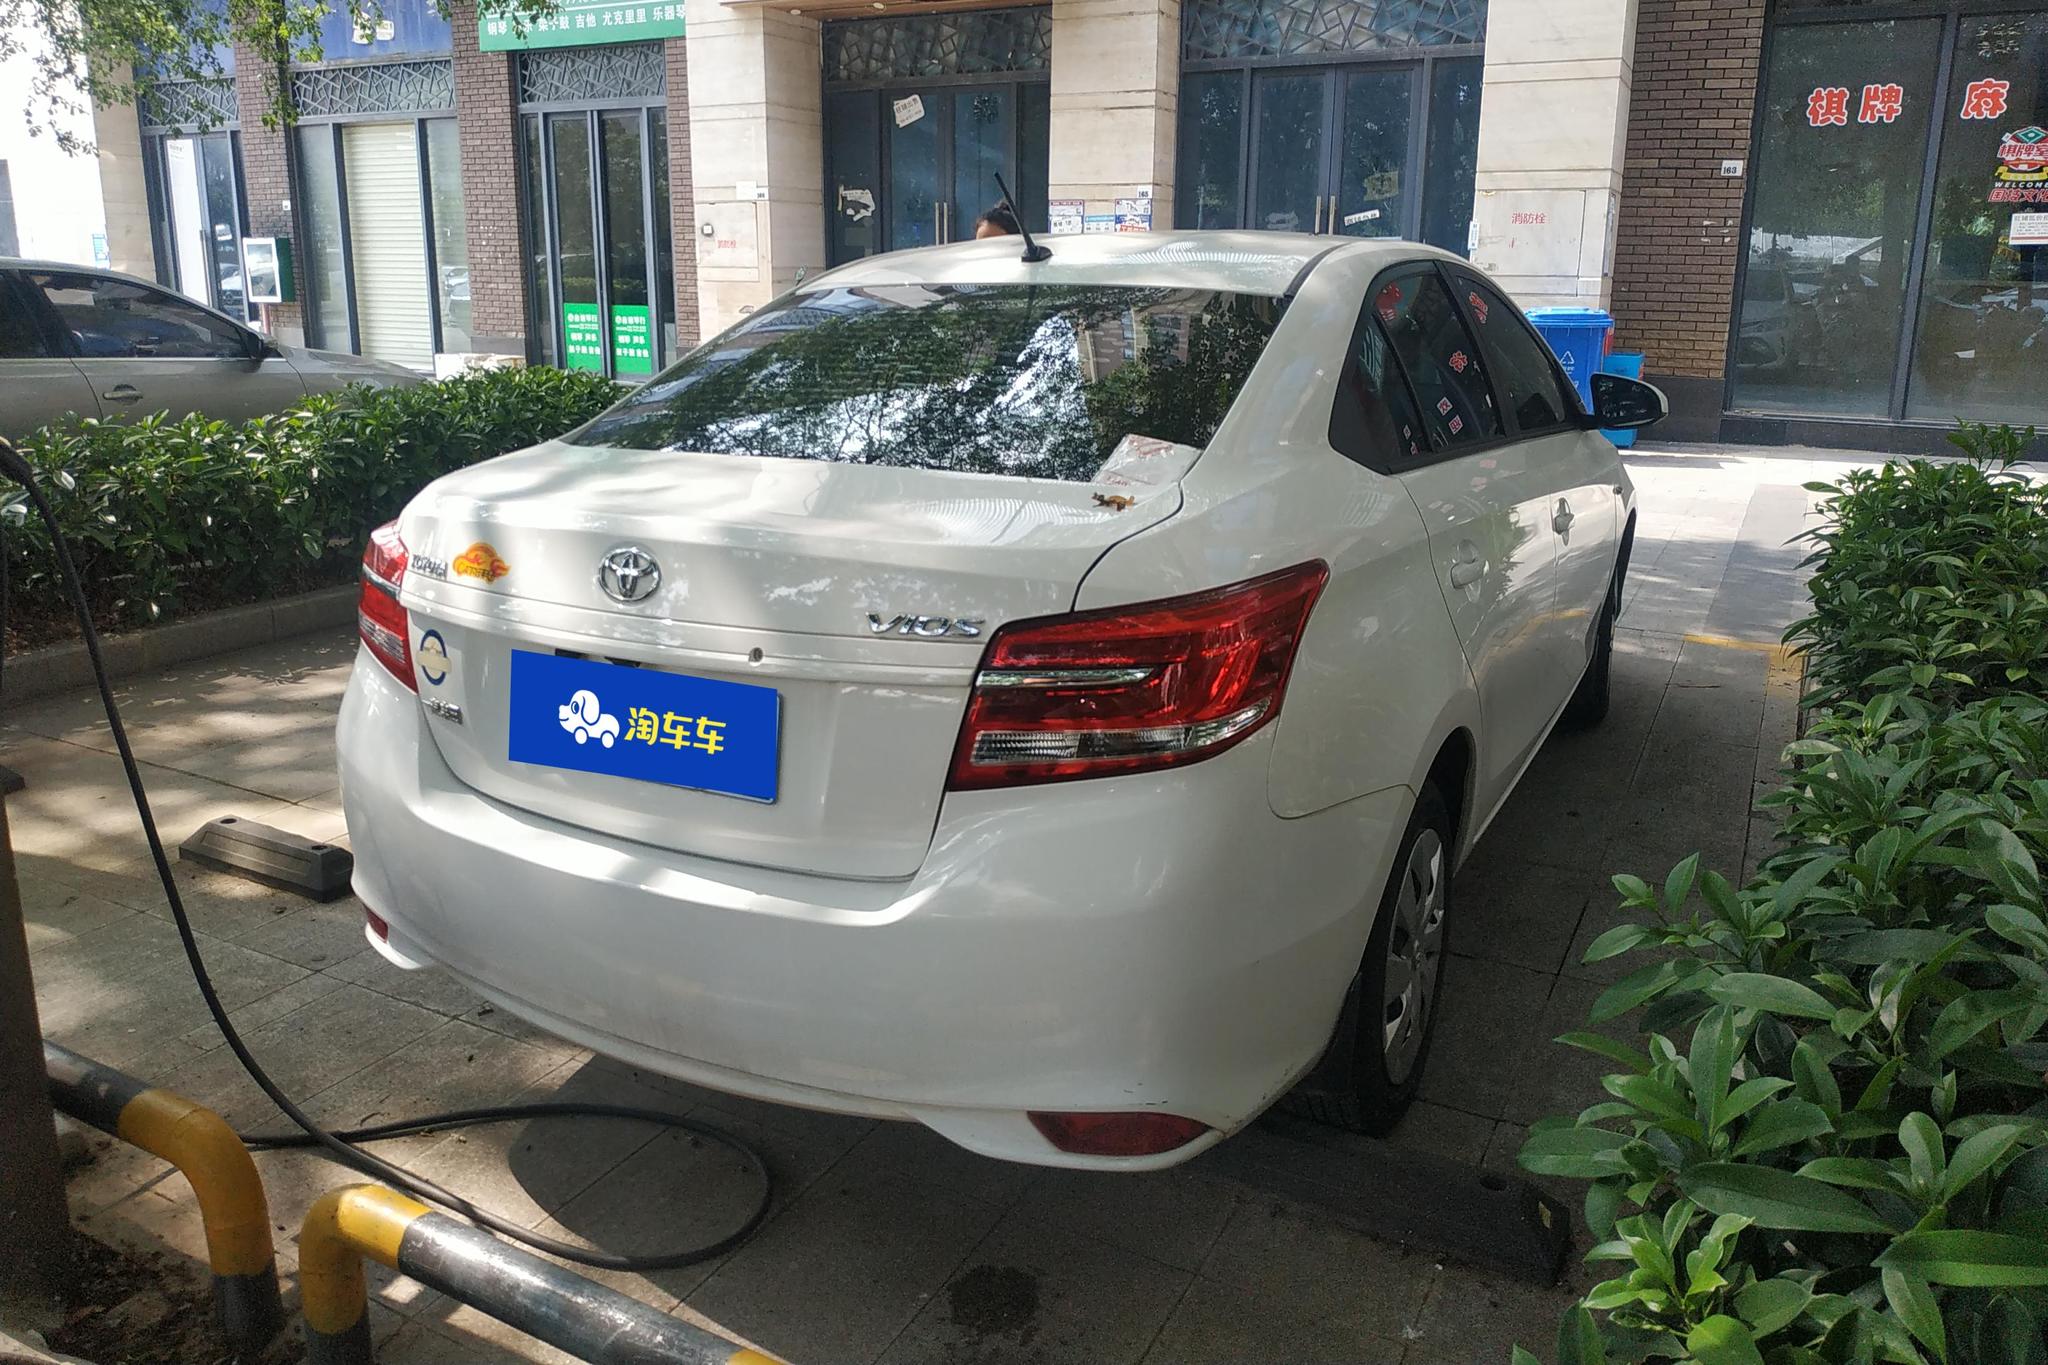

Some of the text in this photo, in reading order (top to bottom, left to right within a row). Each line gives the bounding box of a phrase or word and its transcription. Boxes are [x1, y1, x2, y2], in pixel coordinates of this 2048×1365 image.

[575, 13, 597, 29] 吉他
[602, 9, 647, 26] 尤克里里
[1806, 78, 2010, 127] 棋牌 麻
[1723, 166, 1737, 175] 163
[1511, 212, 1546, 225] 消防栓
[864, 610, 986, 638] VIOS
